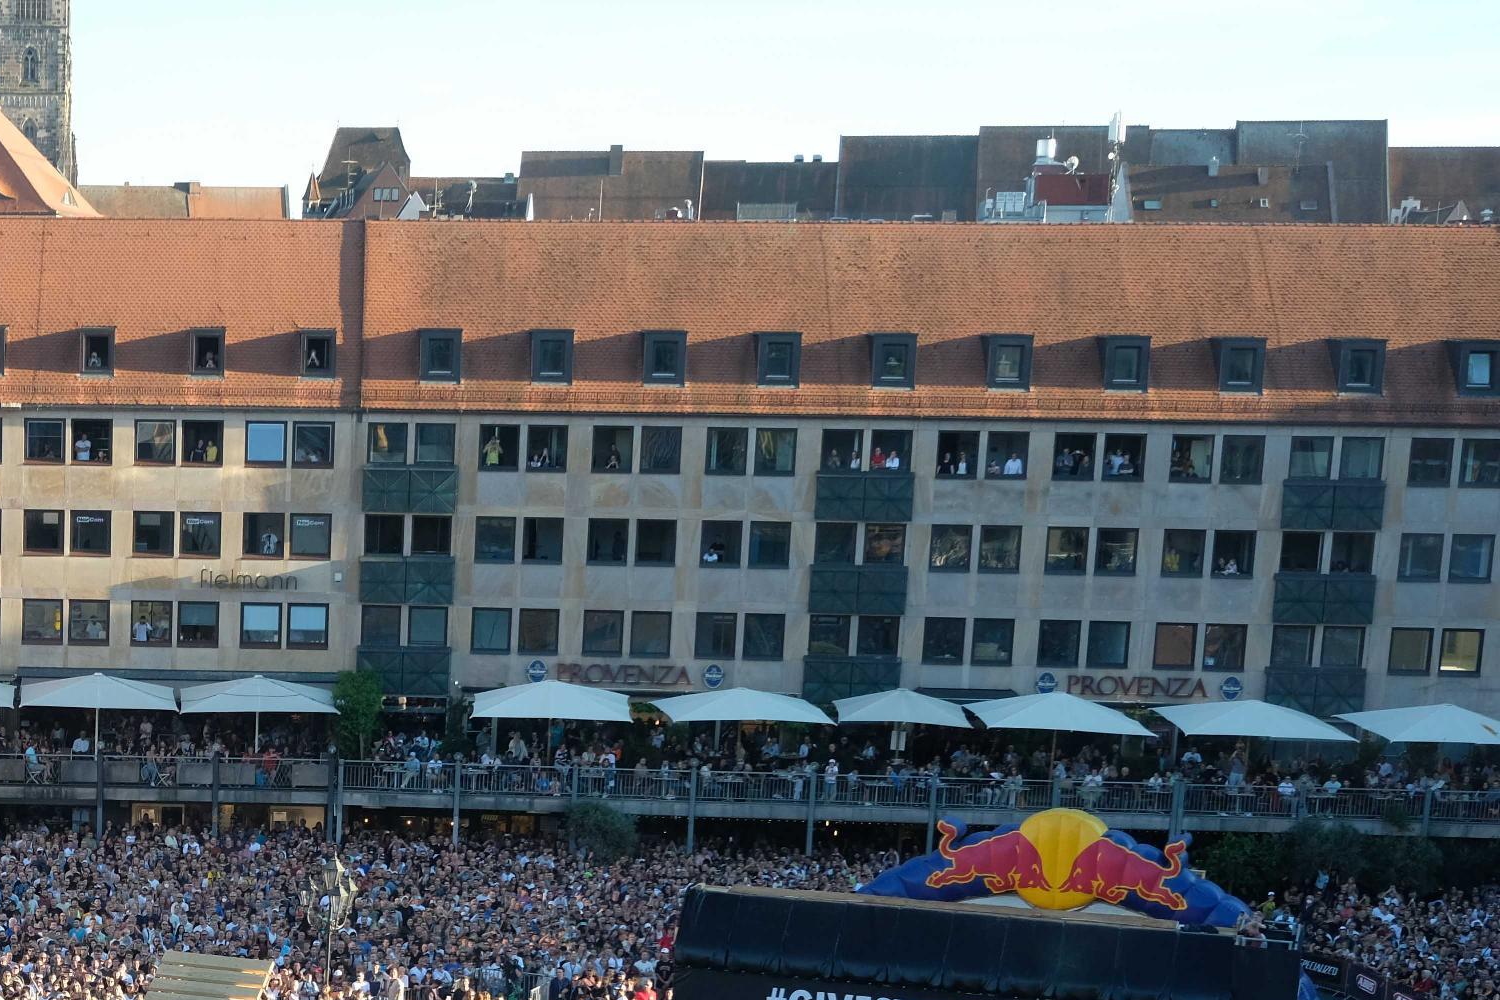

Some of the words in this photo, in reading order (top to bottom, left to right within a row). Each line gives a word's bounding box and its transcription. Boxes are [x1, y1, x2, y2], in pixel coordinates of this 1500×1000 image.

[200, 568, 299, 590] fielmann
[556, 662, 693, 686] PROVENZA
[1066, 675, 1209, 698] PROVENZA
